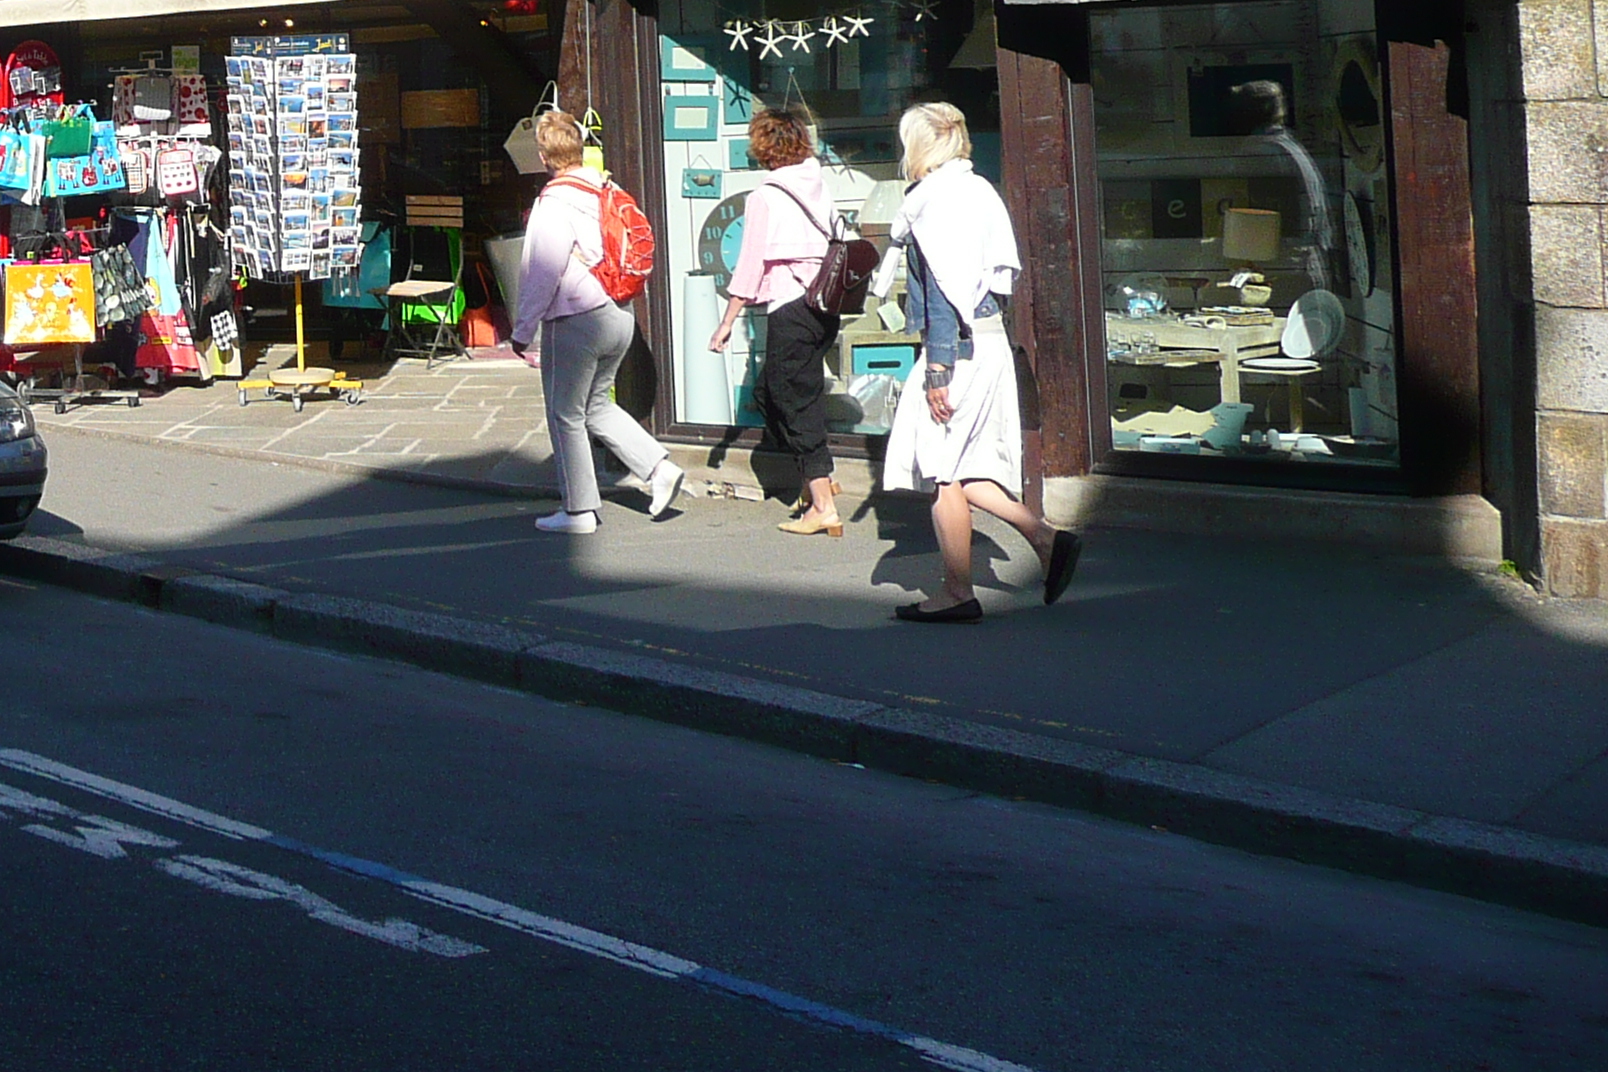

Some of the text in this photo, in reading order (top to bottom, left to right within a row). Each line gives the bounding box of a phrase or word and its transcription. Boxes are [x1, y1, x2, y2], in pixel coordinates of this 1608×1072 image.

[720, 205, 735, 220] 11
[705, 226, 721, 240] 10
[703, 251, 713, 265] 9
[715, 273, 724, 286] 8
